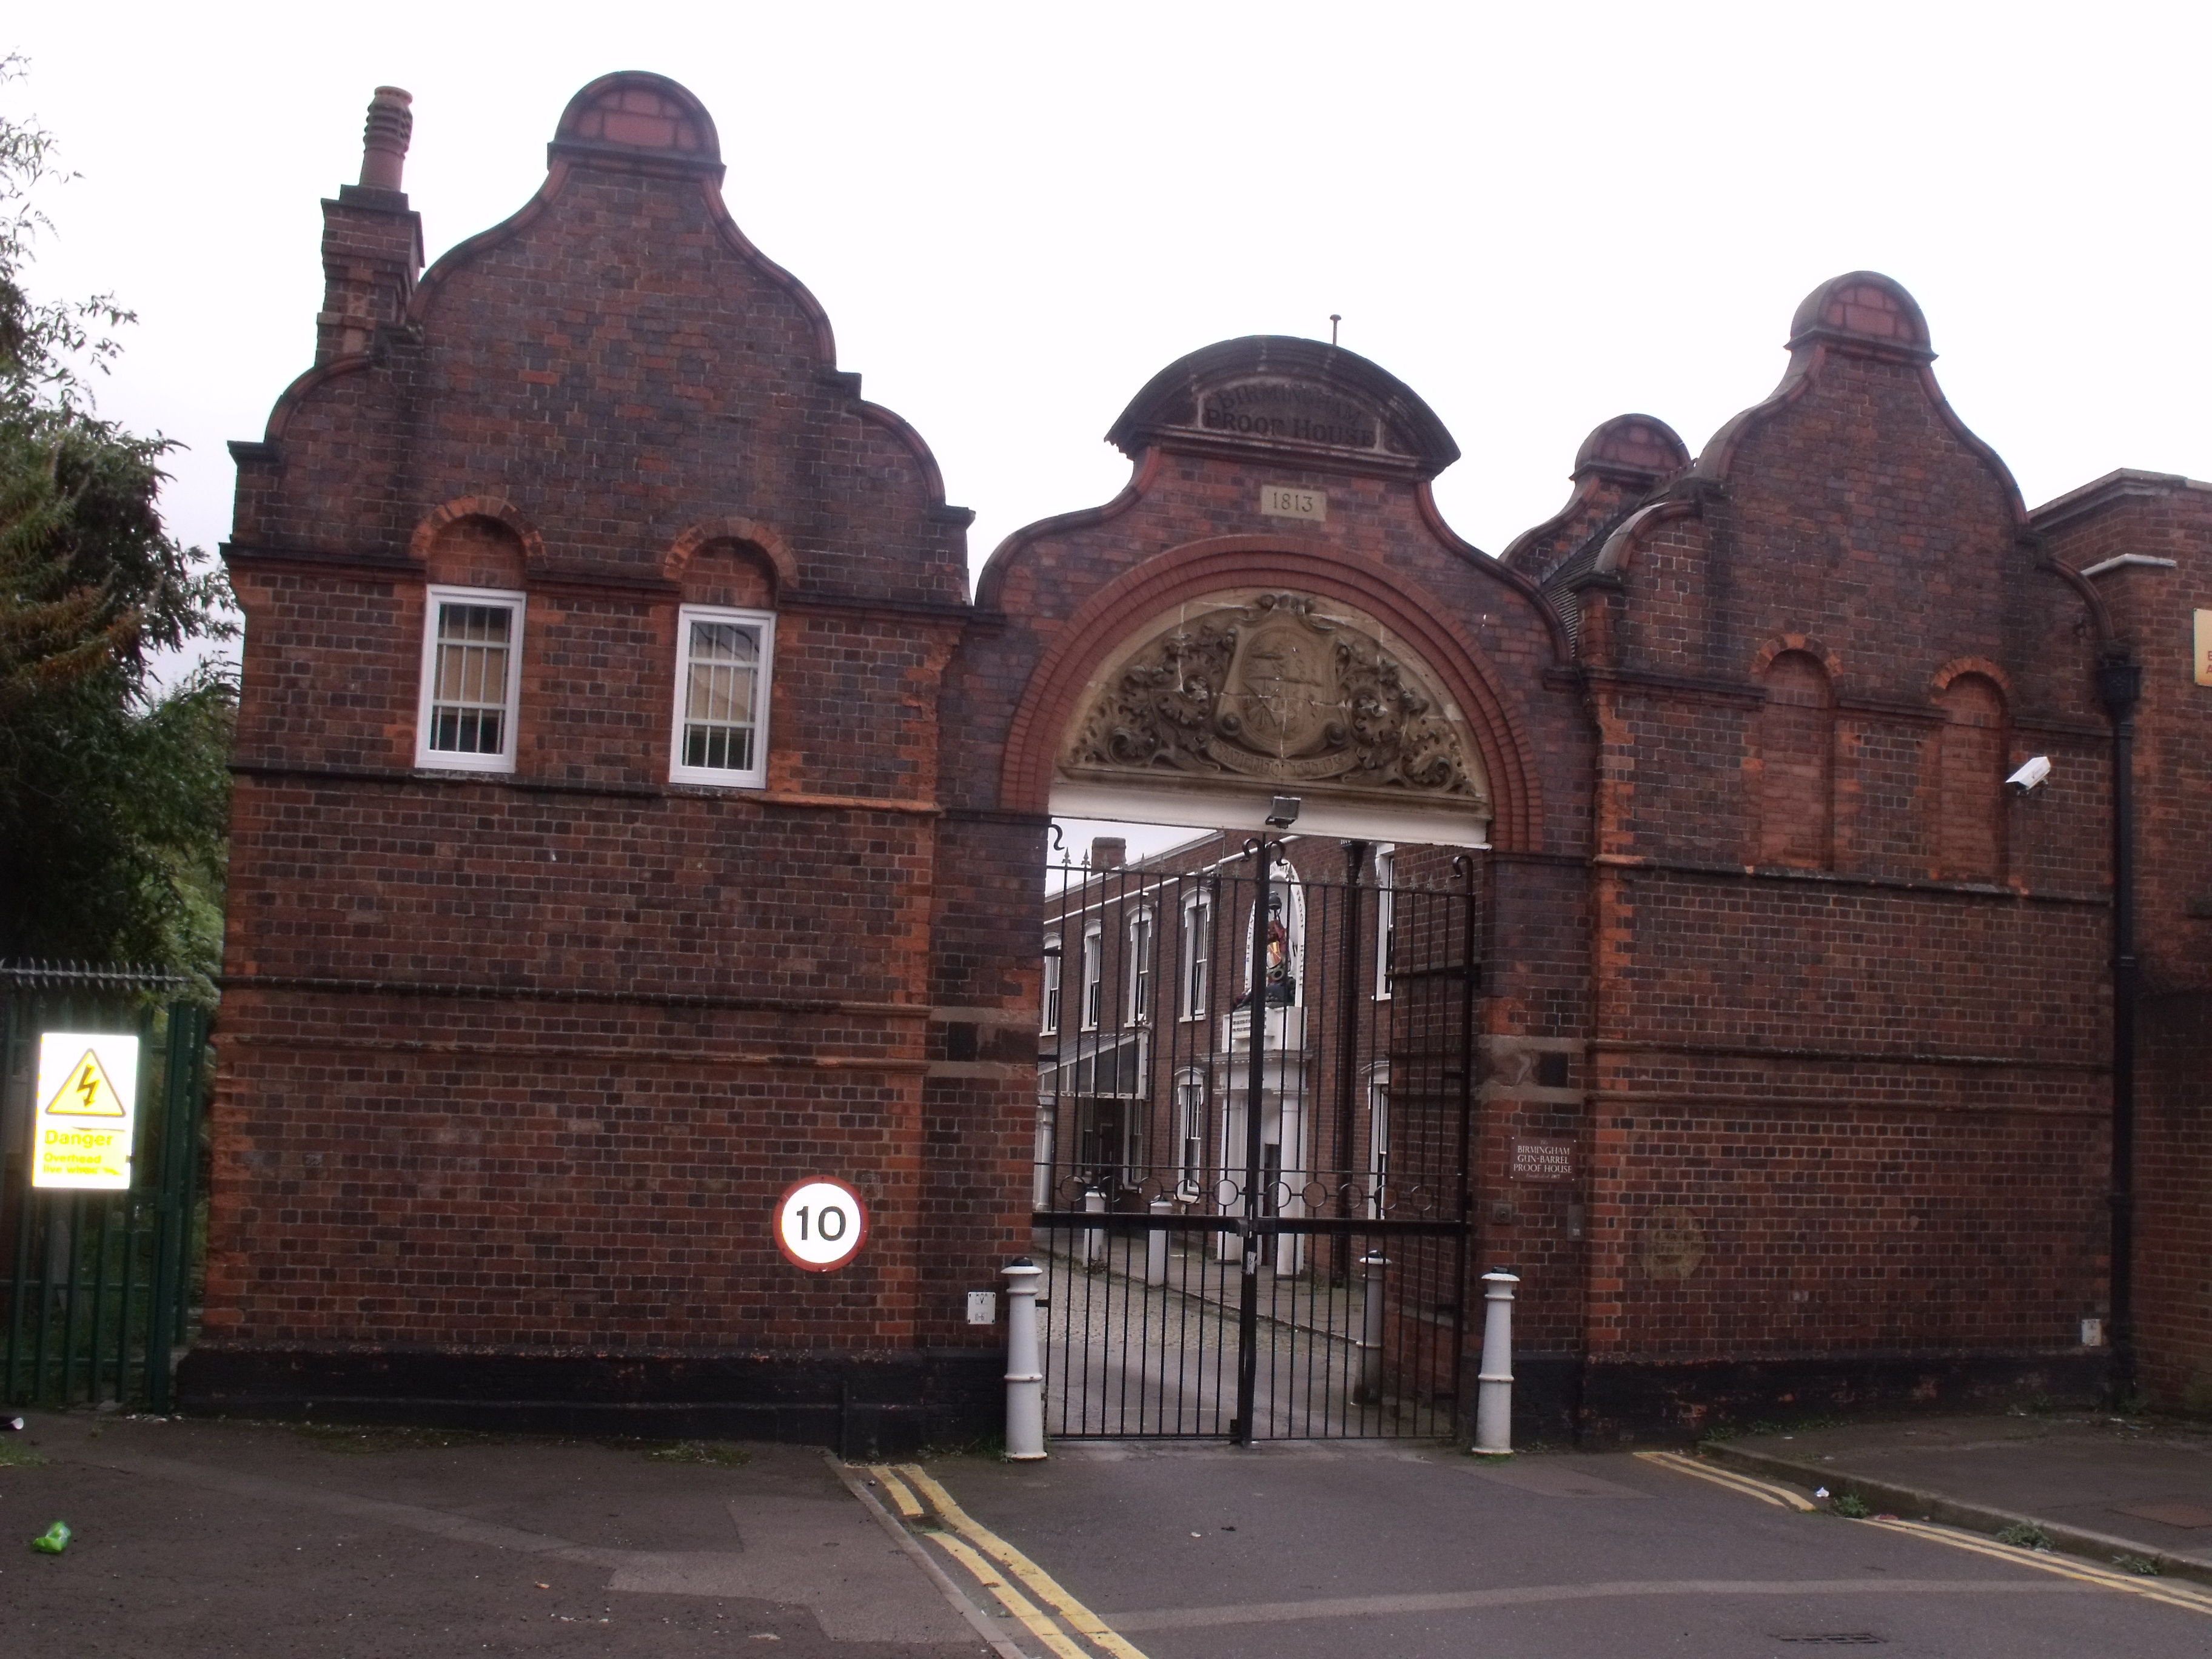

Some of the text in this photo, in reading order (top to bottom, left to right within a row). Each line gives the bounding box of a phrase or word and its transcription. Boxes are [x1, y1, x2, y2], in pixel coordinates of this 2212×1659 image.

[1204, 409, 1373, 447] PROOF HOUSE
[1274, 492, 1312, 512] 1813
[45, 1130, 113, 1148] Danger
[1518, 1145, 1569, 1155] BIRMINGHAM
[44, 1153, 102, 1164] Overhead
[1518, 1155, 1569, 1164] GUN-BARREL
[43, 1164, 62, 1173] live
[1513, 1164, 1572, 1173] PROOF HOUSE
[796, 1205, 846, 1241] 10
